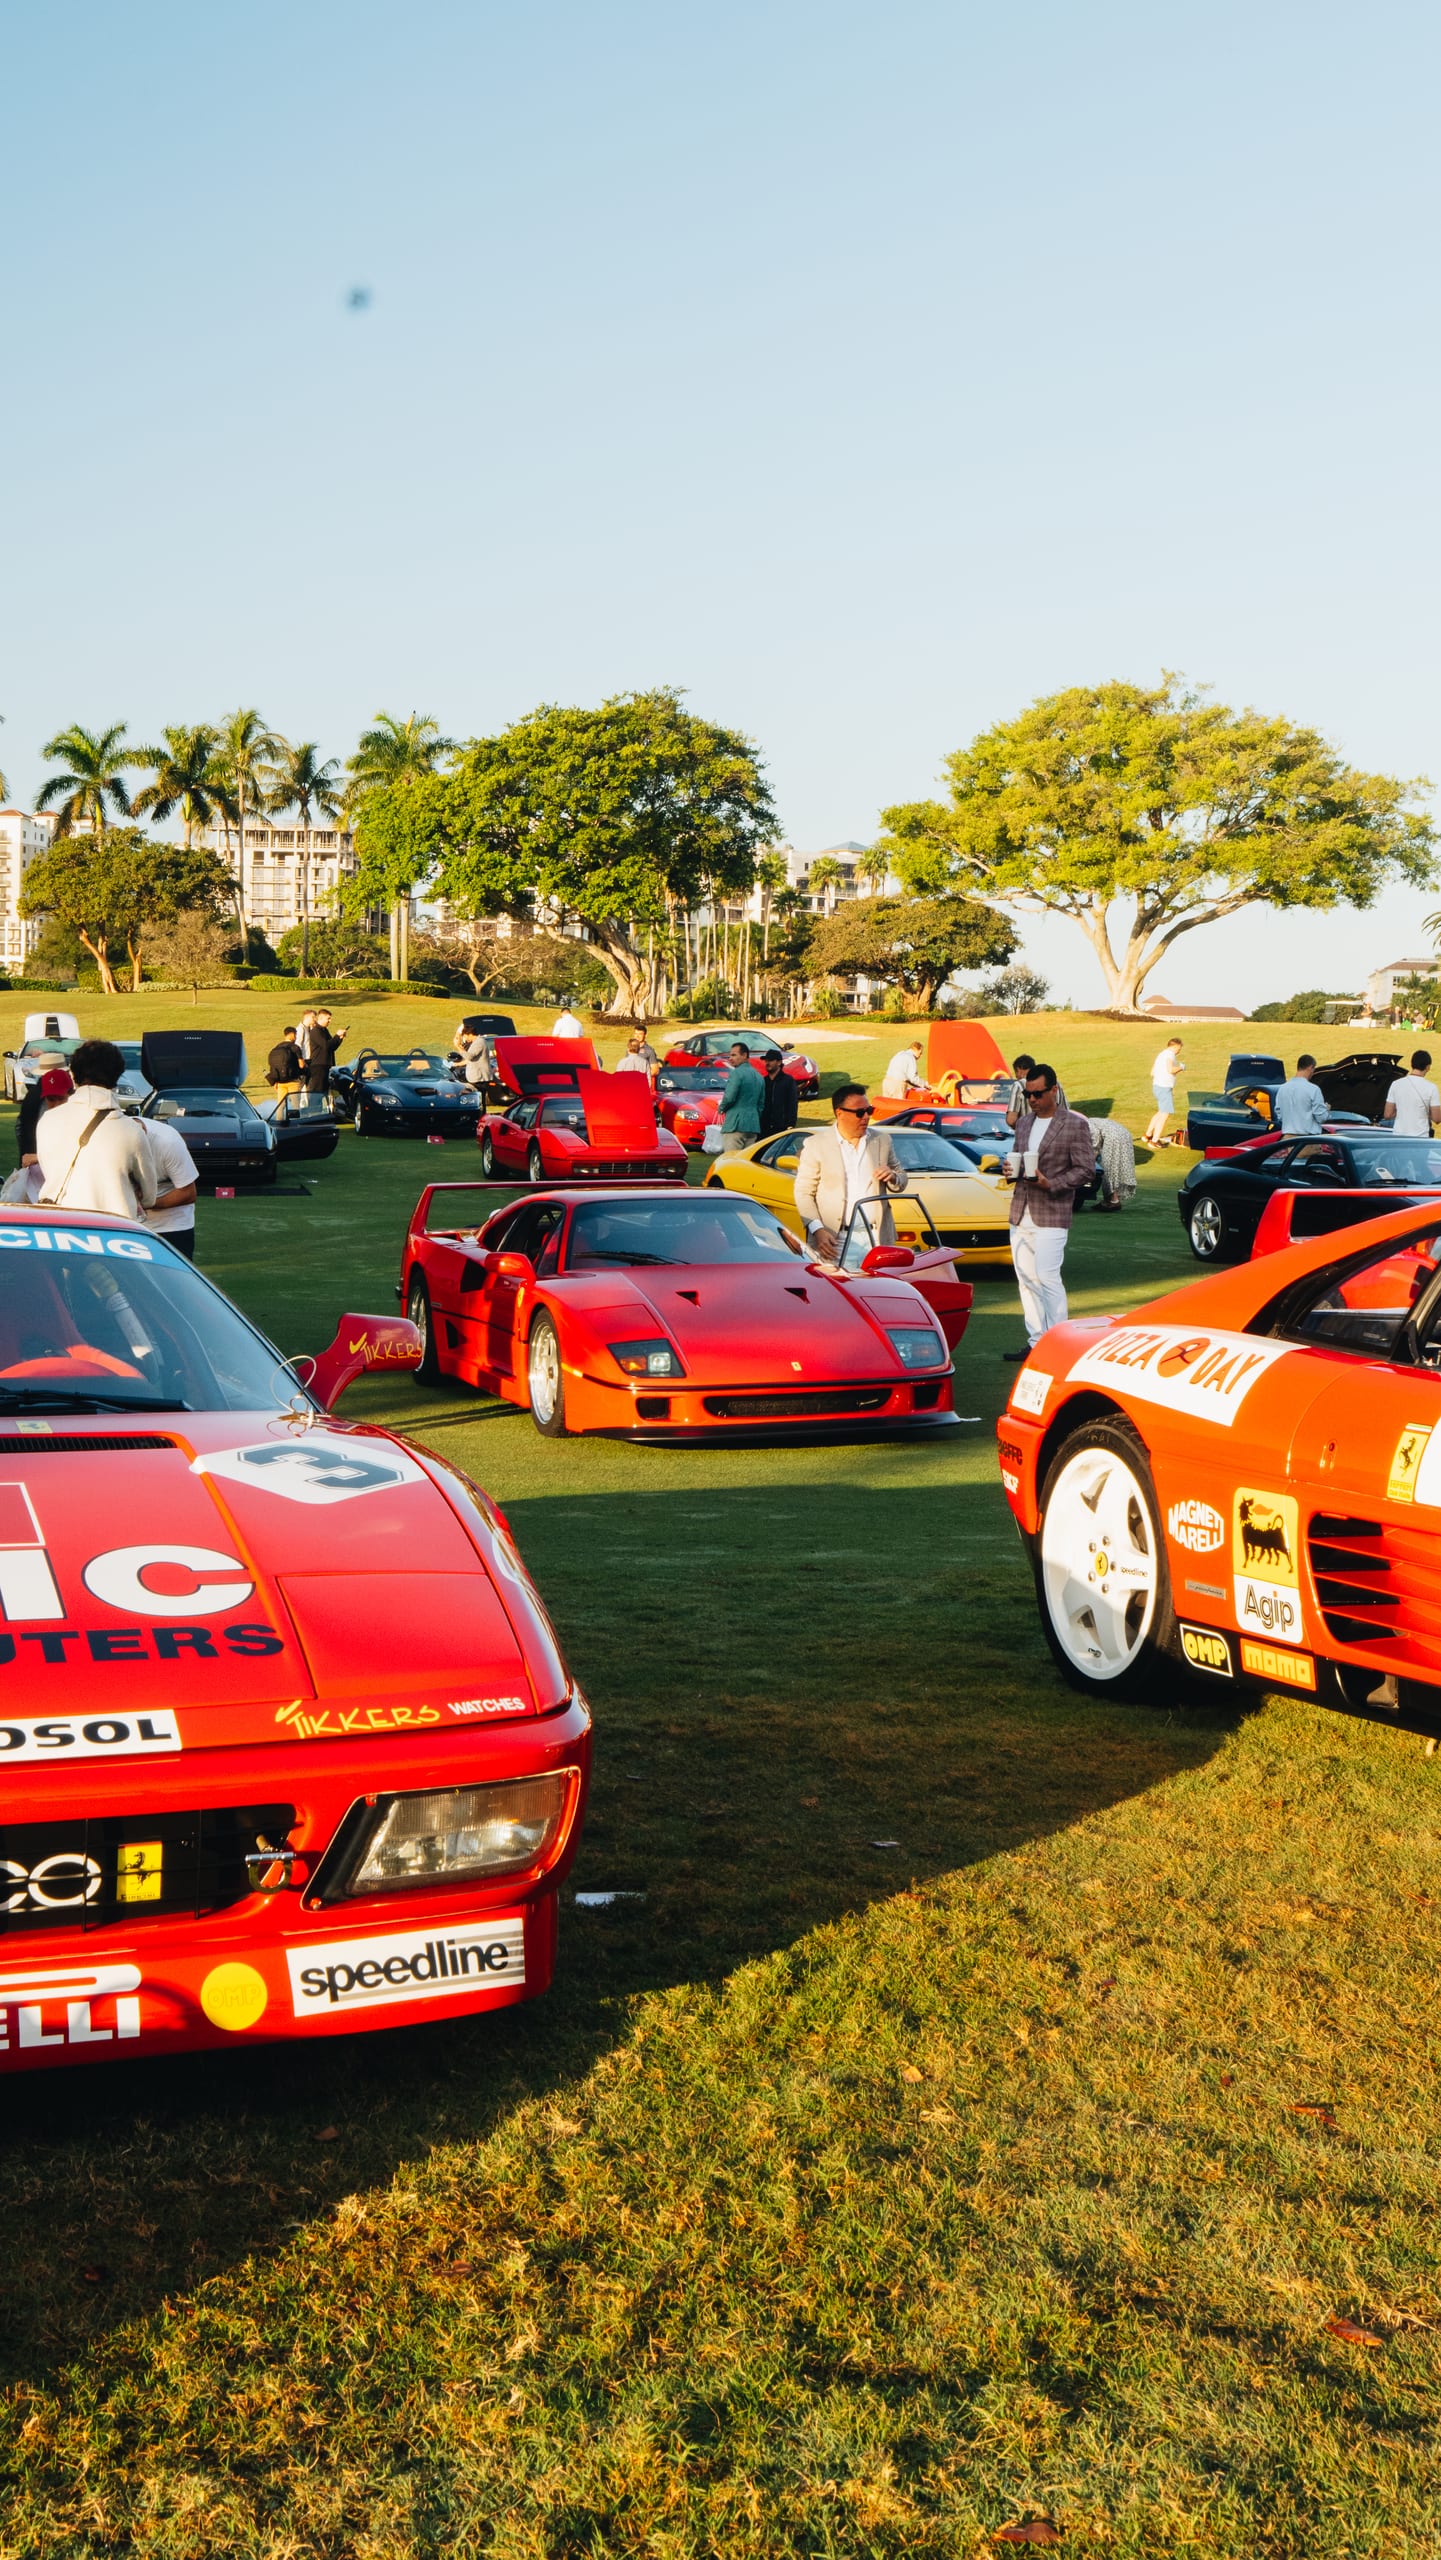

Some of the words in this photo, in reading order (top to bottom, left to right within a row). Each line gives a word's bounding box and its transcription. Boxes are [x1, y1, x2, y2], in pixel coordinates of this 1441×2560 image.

[360, 1340, 423, 1364] TIKKERS
[1087, 1332, 1170, 1370] PIZZA
[1189, 1347, 1265, 1394] DAY
[237, 1444, 405, 1492] 3
[1168, 1499, 1224, 1530] MAGNETI
[1244, 1584, 1294, 1632] Agip
[1183, 1632, 1227, 1667] OMP
[286, 1705, 441, 1739] TIKKERS
[448, 1697, 527, 1716] WATCHES
[300, 1939, 509, 2003] speedline
[207, 1983, 262, 2010] OMP
